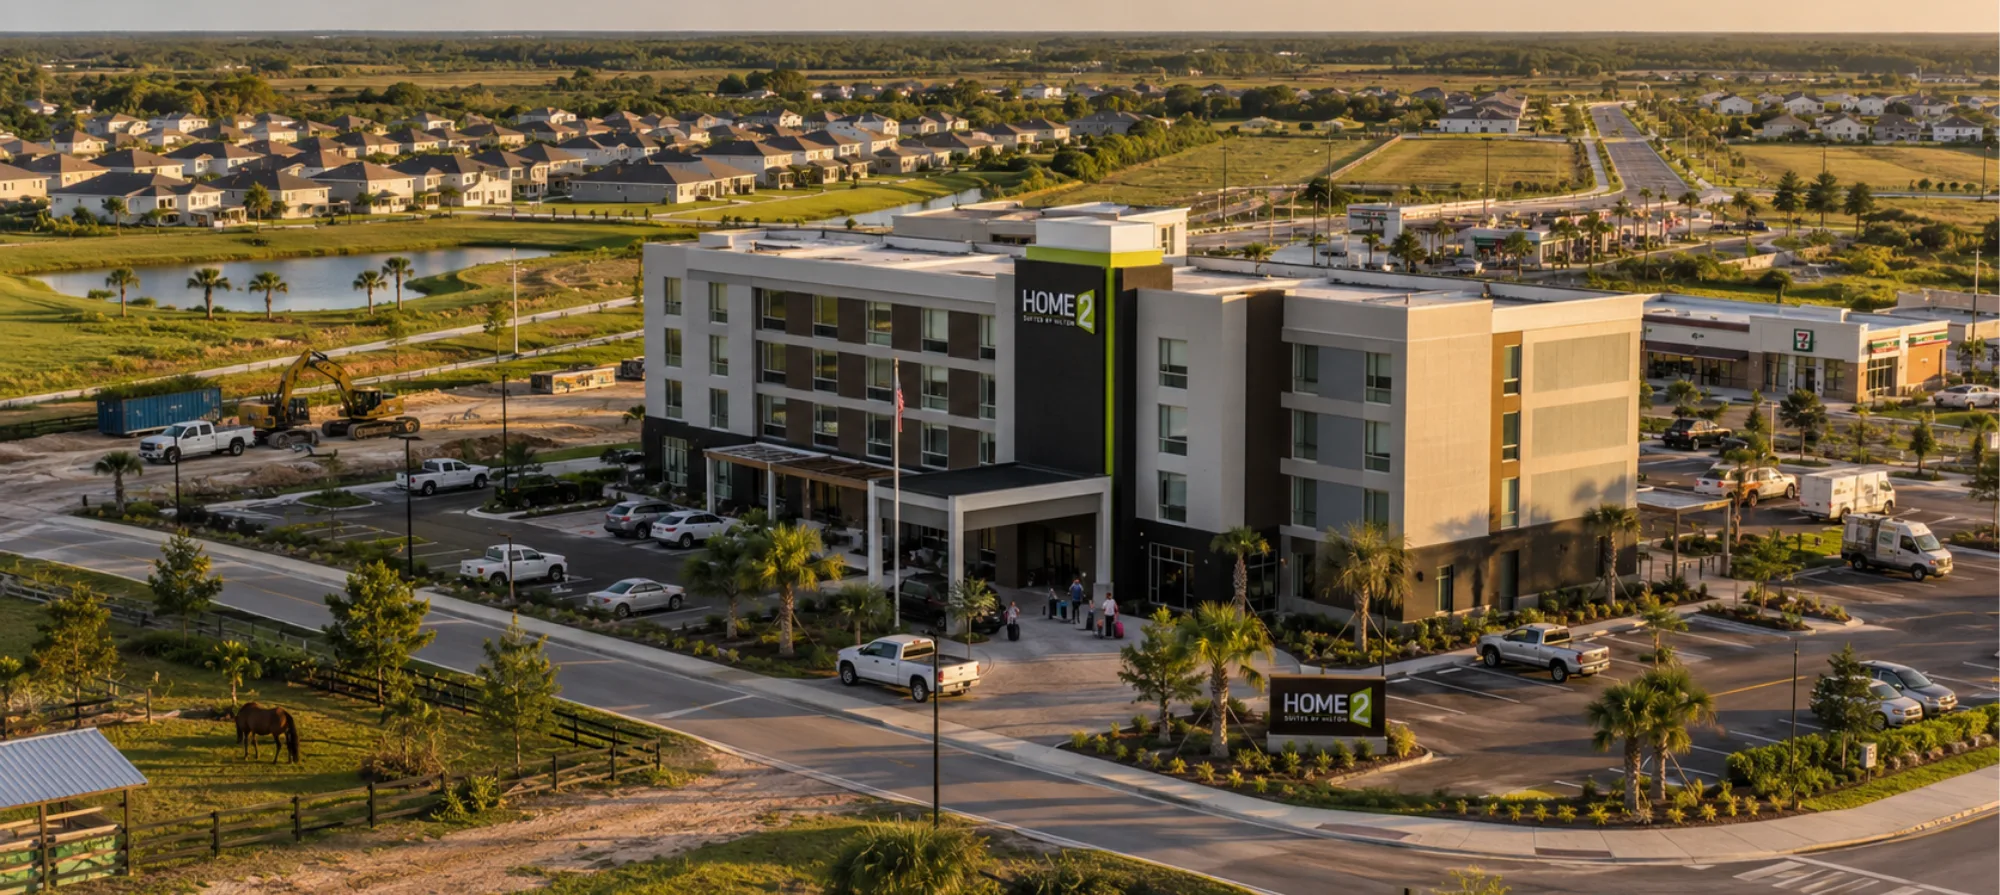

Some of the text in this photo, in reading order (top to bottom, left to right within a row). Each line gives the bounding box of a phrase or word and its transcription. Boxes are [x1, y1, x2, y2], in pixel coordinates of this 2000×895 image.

[1023, 289, 1092, 328] HOME 2
[1283, 692, 1369, 723] HOME 2
